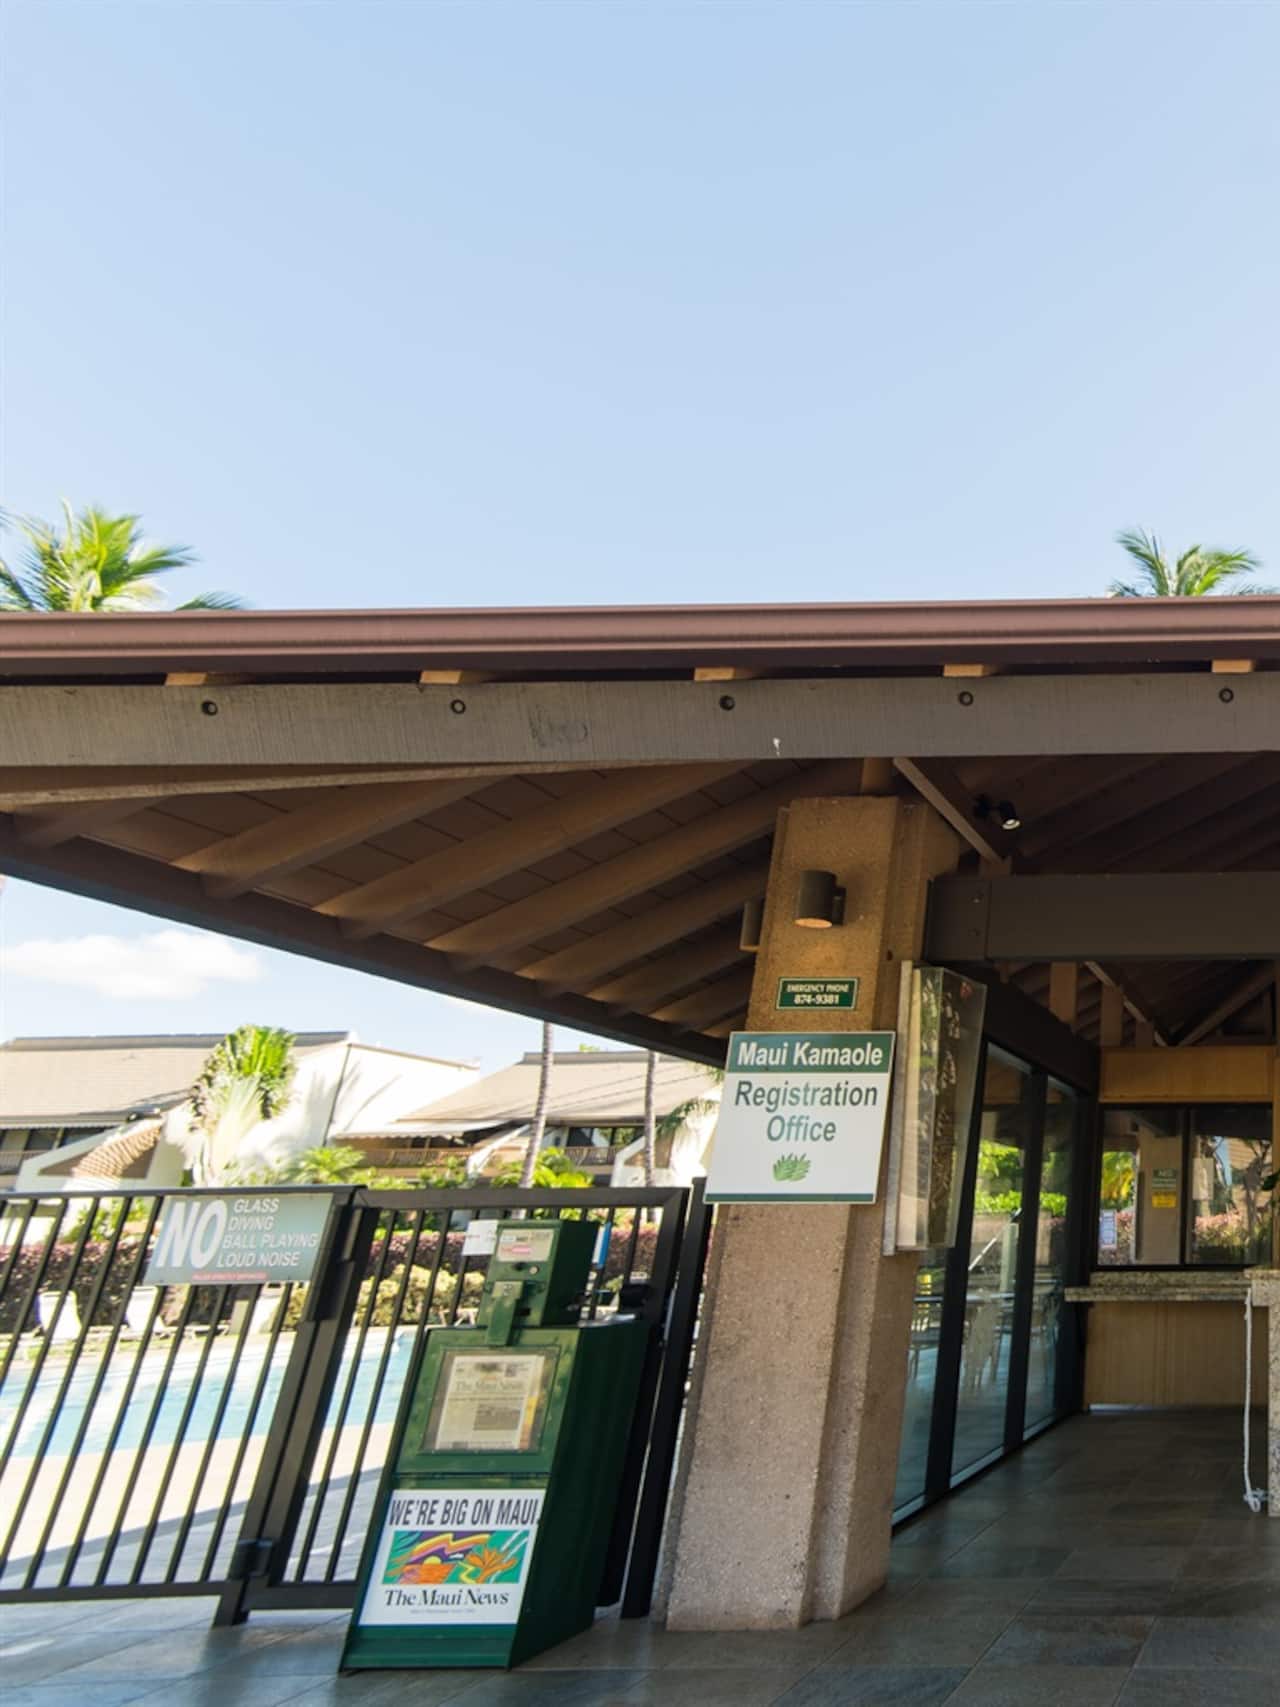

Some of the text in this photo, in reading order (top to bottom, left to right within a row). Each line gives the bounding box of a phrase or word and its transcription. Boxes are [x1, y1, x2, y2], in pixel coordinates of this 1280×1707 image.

[786, 984, 849, 992] EMERGENCY PHONE
[737, 1041, 883, 1066] Maui Kamaole
[735, 1080, 878, 1113] Registration
[767, 1114, 836, 1142] Office
[234, 1199, 280, 1213] GLASS
[227, 1216, 274, 1230] DIVING
[156, 1199, 228, 1269] NO
[223, 1233, 319, 1249] BALL PLAYING
[216, 1251, 300, 1268] LOUD NOISE
[389, 1498, 441, 1526] WE'RE
[440, 1498, 468, 1526] BIG
[471, 1498, 494, 1525] ON
[385, 1587, 510, 1607] The Maui News
